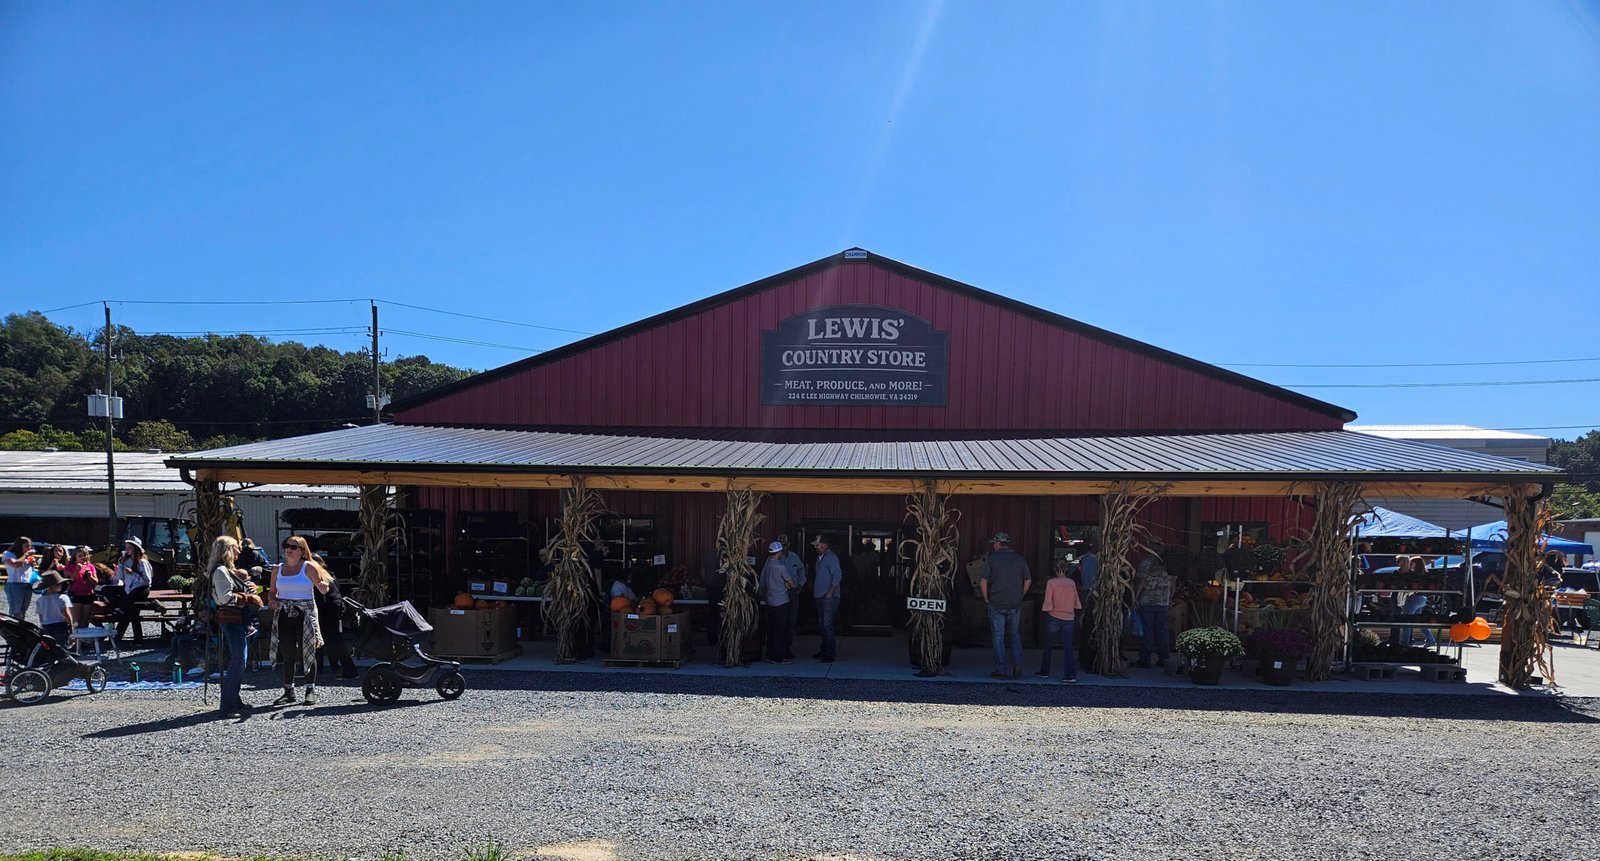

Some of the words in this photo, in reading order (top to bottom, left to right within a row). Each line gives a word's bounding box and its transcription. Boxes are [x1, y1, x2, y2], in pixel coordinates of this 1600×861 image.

[782, 350, 864, 366] COUNTRY
[867, 350, 926, 367] STORE
[784, 380, 814, 390] MEAT,
[816, 380, 867, 391] PRODUCE,
[888, 381, 922, 390] MORE!
[909, 600, 944, 610] OPEN
